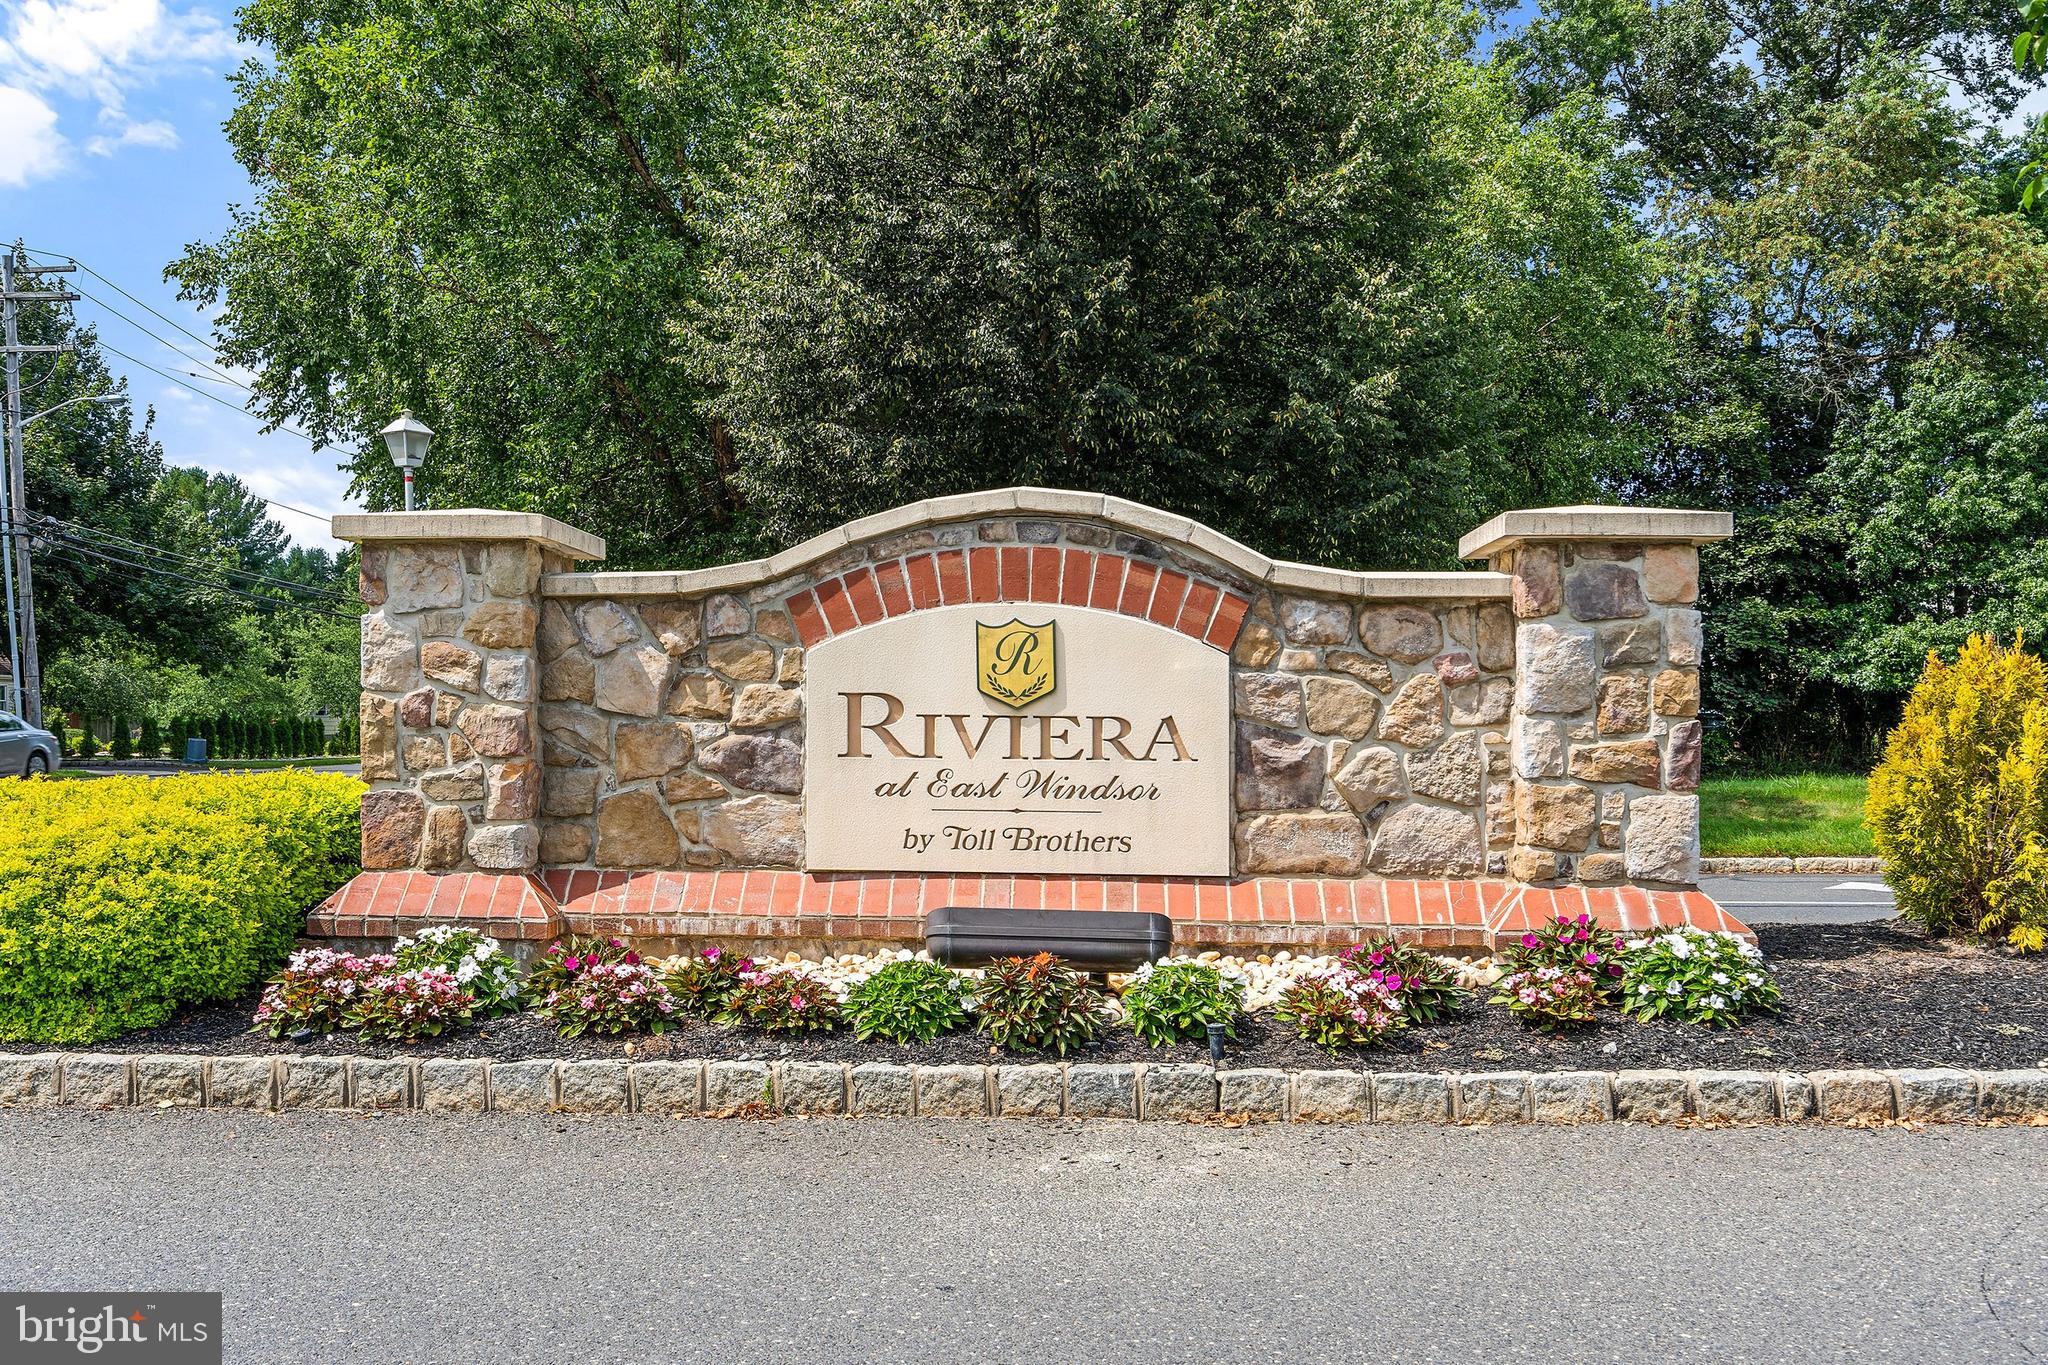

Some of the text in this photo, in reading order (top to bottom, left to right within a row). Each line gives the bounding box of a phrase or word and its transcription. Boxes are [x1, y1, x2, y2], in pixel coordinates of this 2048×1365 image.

[837, 692, 1199, 762] RIVIERA
[874, 768, 1162, 802] at East Windsor
[903, 825, 1132, 854] by Toll Brothers
